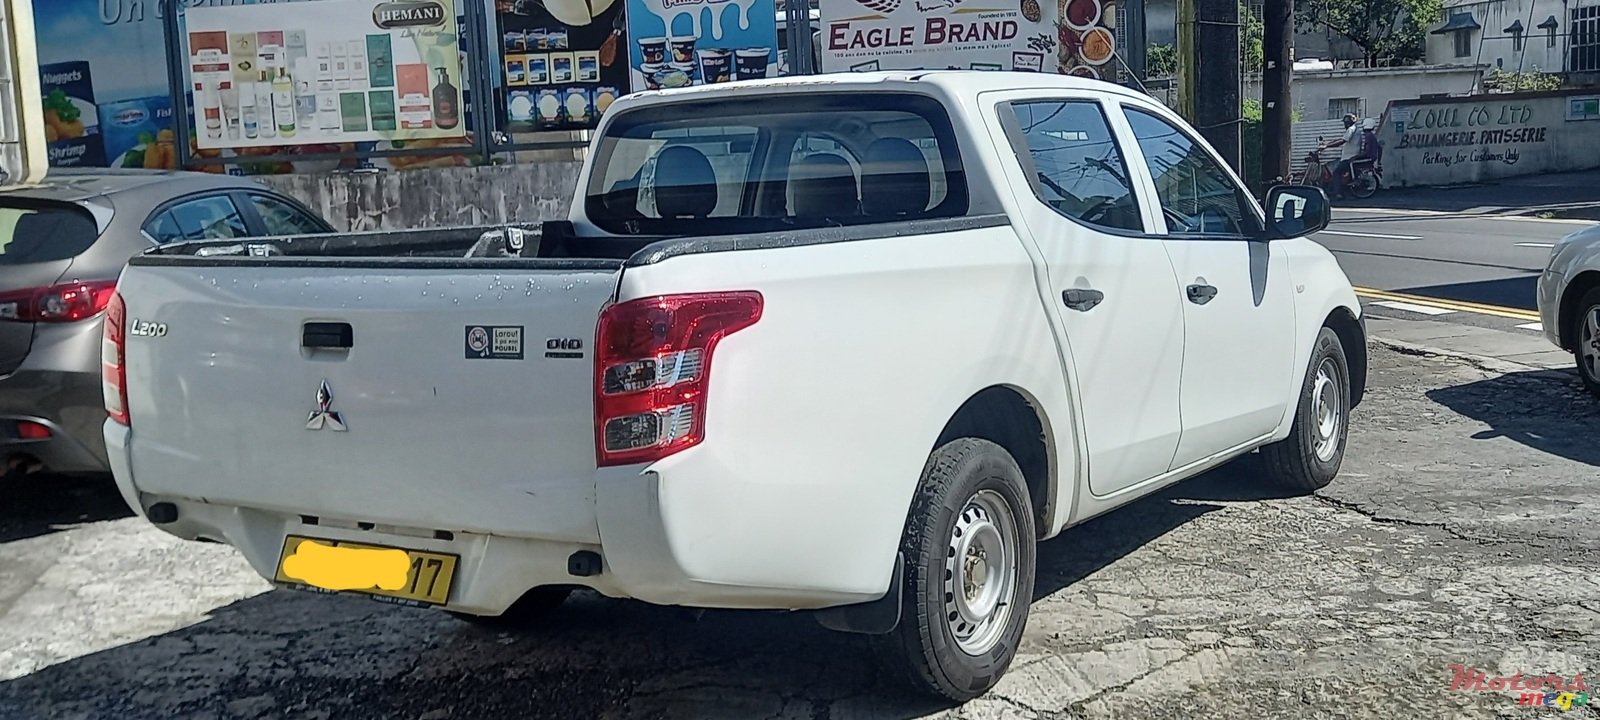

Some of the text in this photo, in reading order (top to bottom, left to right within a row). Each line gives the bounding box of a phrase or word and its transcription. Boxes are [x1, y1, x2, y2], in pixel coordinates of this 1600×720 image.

[380, 7, 441, 22] HEMANI
[828, 16, 1019, 51] EAGLE BRAND
[42, 69, 83, 85] Nuggets
[1468, 105, 1490, 127] CO
[1498, 103, 1532, 126] LTD
[1395, 131, 1476, 149] BOULANGERIE
[1479, 127, 1547, 145] PATISSERIE
[48, 144, 86, 160] Shrimp
[1453, 150, 1468, 164] for
[1502, 148, 1520, 165] Only
[131, 318, 168, 337] L200
[495, 329, 518, 338] Larout
[411, 556, 443, 597] 17
